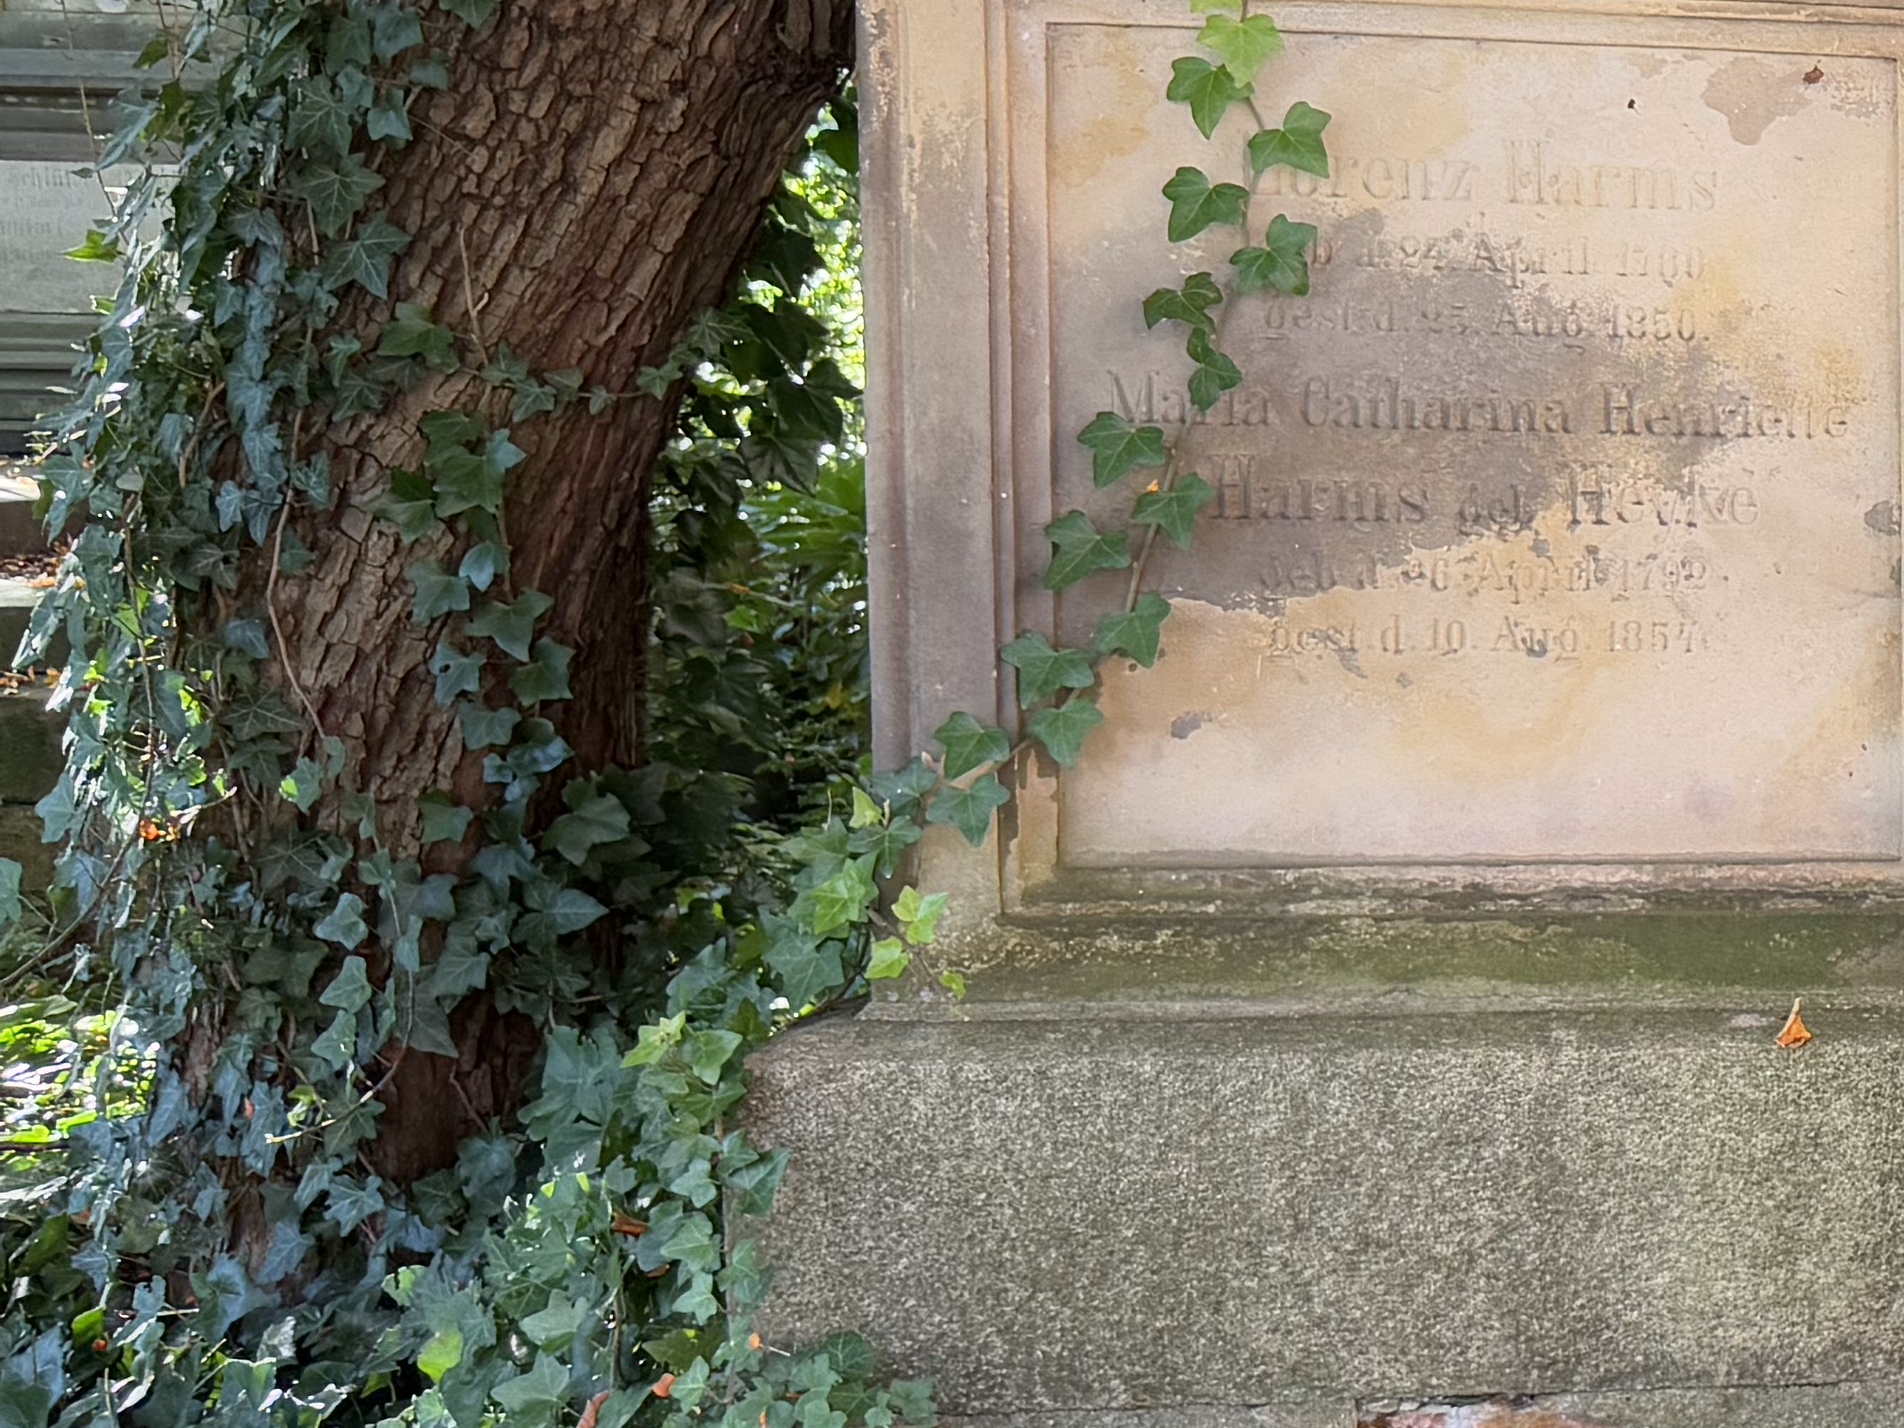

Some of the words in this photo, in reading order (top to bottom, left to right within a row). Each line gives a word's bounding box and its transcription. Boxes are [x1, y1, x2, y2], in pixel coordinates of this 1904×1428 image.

[1504, 139, 1717, 212] Harms
[1302, 375, 1571, 435] Catharina
[1206, 454, 1427, 524] Harms
